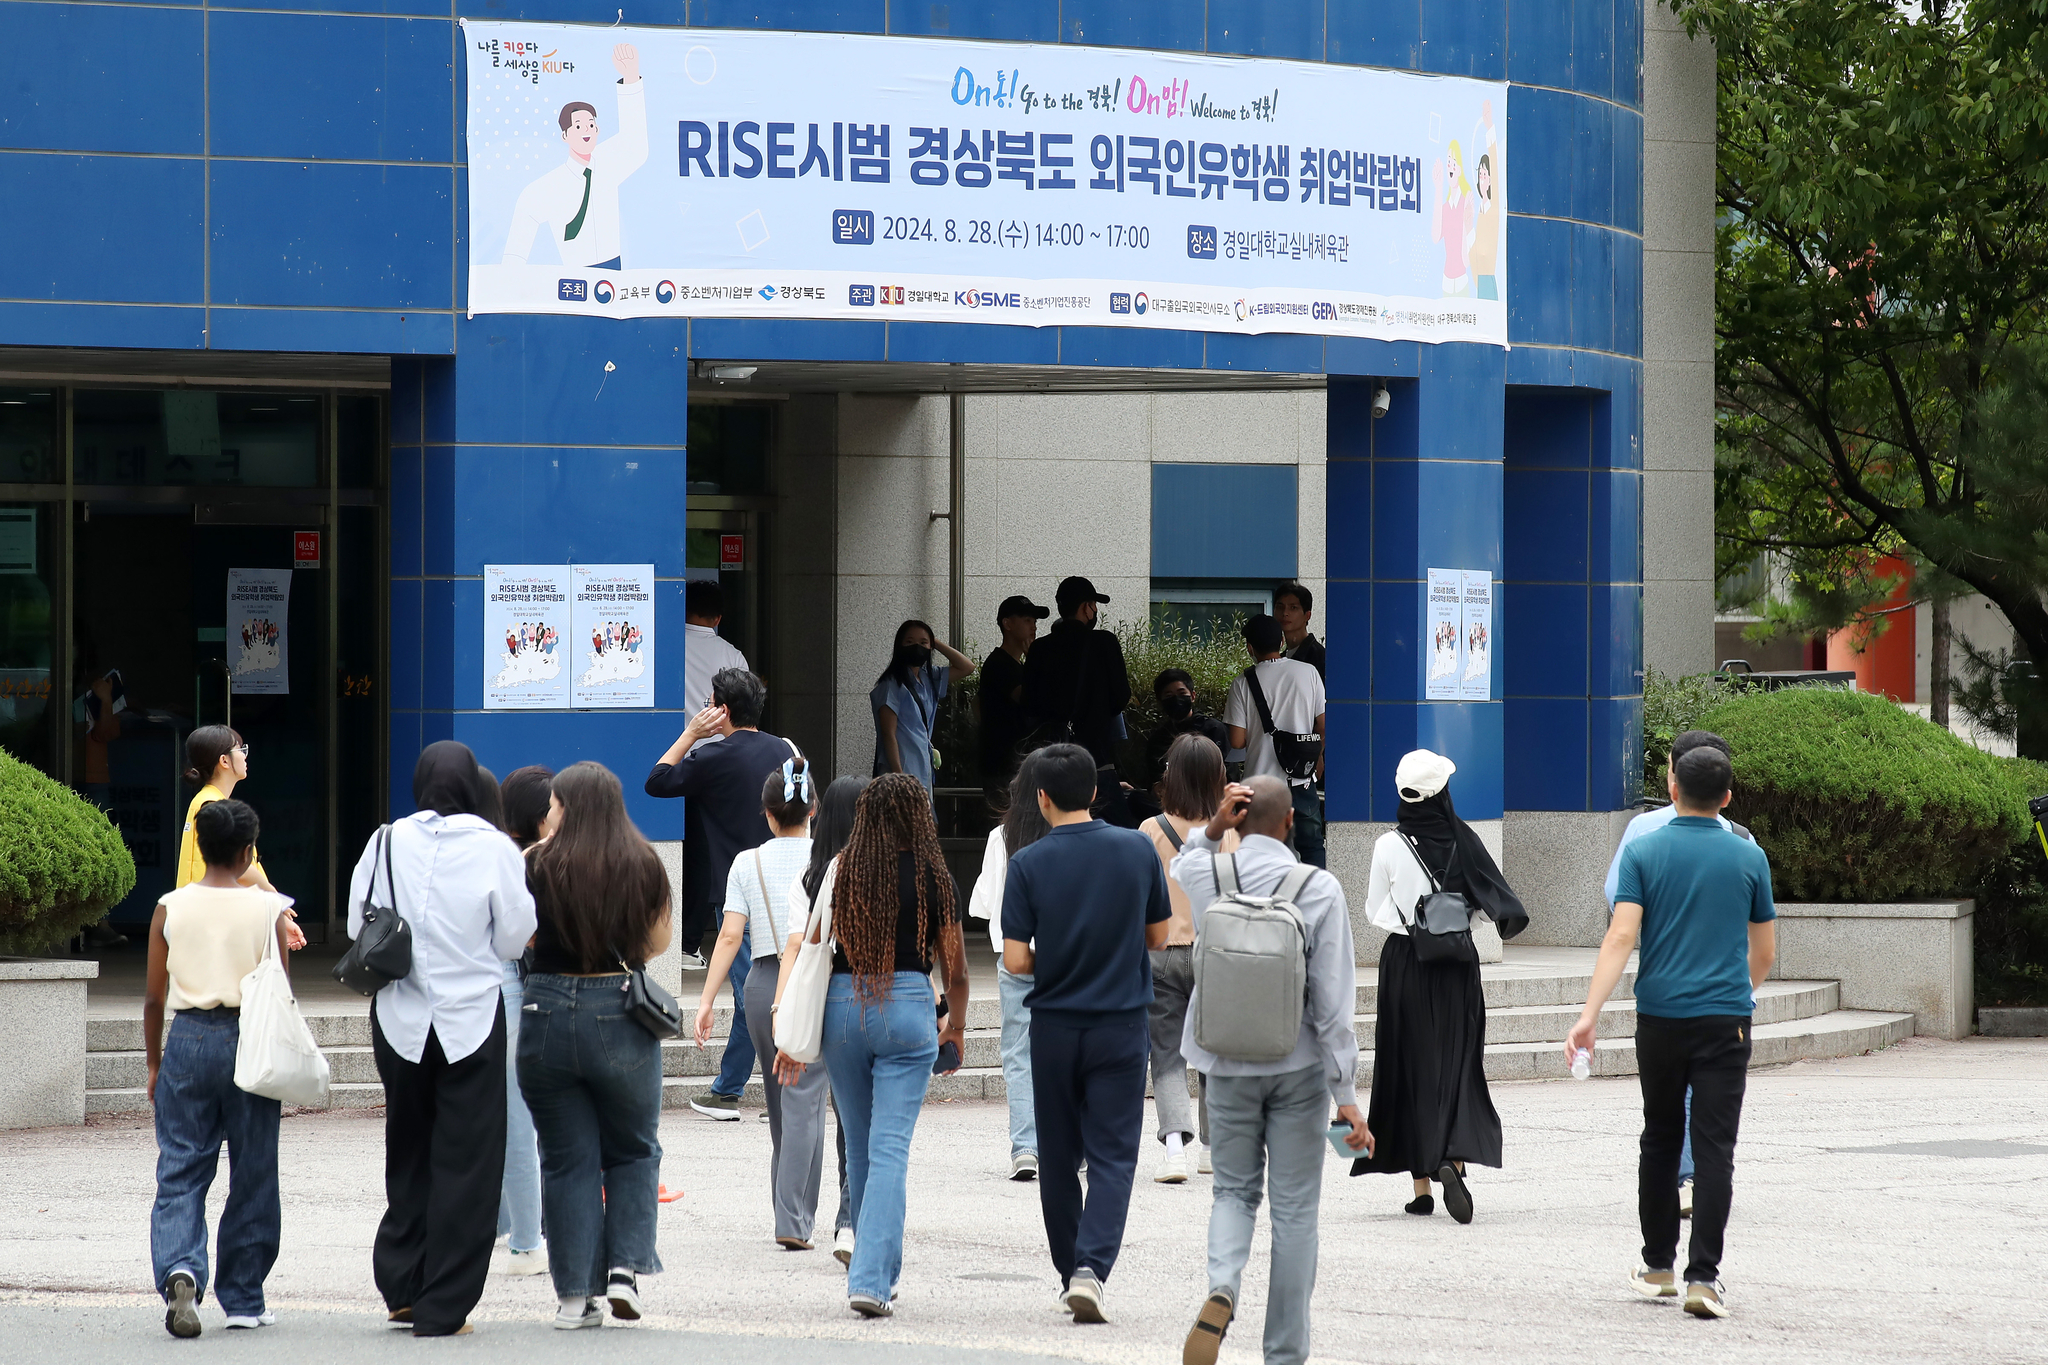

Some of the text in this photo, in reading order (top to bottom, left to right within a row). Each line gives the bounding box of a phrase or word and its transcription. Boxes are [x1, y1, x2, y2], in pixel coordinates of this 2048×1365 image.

[478, 39, 539, 67] 나를 키우다
[504, 59, 575, 84] 세상을 KIU다
[951, 65, 1279, 123] On통! Go to the 경북! On맘! Welcome to 경북!
[678, 120, 1421, 214] RISE시범 경상북도 외국인유학생 취업박람회
[837, 214, 870, 240] 일시
[883, 216, 938, 243] 2024.
[944, 218, 961, 243] 8.
[1035, 222, 1084, 247] 14:00
[1106, 224, 1150, 249] 17:00
[1190, 230, 1349, 263] 장소 경일대학교실내체육관
[561, 282, 826, 301] 주최 교육부 중소벤처기업부 경상북도
[851, 288, 873, 305] 주관
[880, 286, 905, 305] KIU
[907, 290, 949, 304] 경일대학교
[1023, 295, 1091, 309] 중소벤처기업진흥공단
[1112, 295, 1129, 311] 협력
[1152, 298, 1231, 316] 대구출입국외국인사무소
[1312, 301, 1338, 321] GEPA
[490, 593, 565, 602] 외국인유학생 취업박람회
[499, 584, 557, 593] RISE시범 경상북도
[585, 584, 641, 592] RISE시범 경상북도
